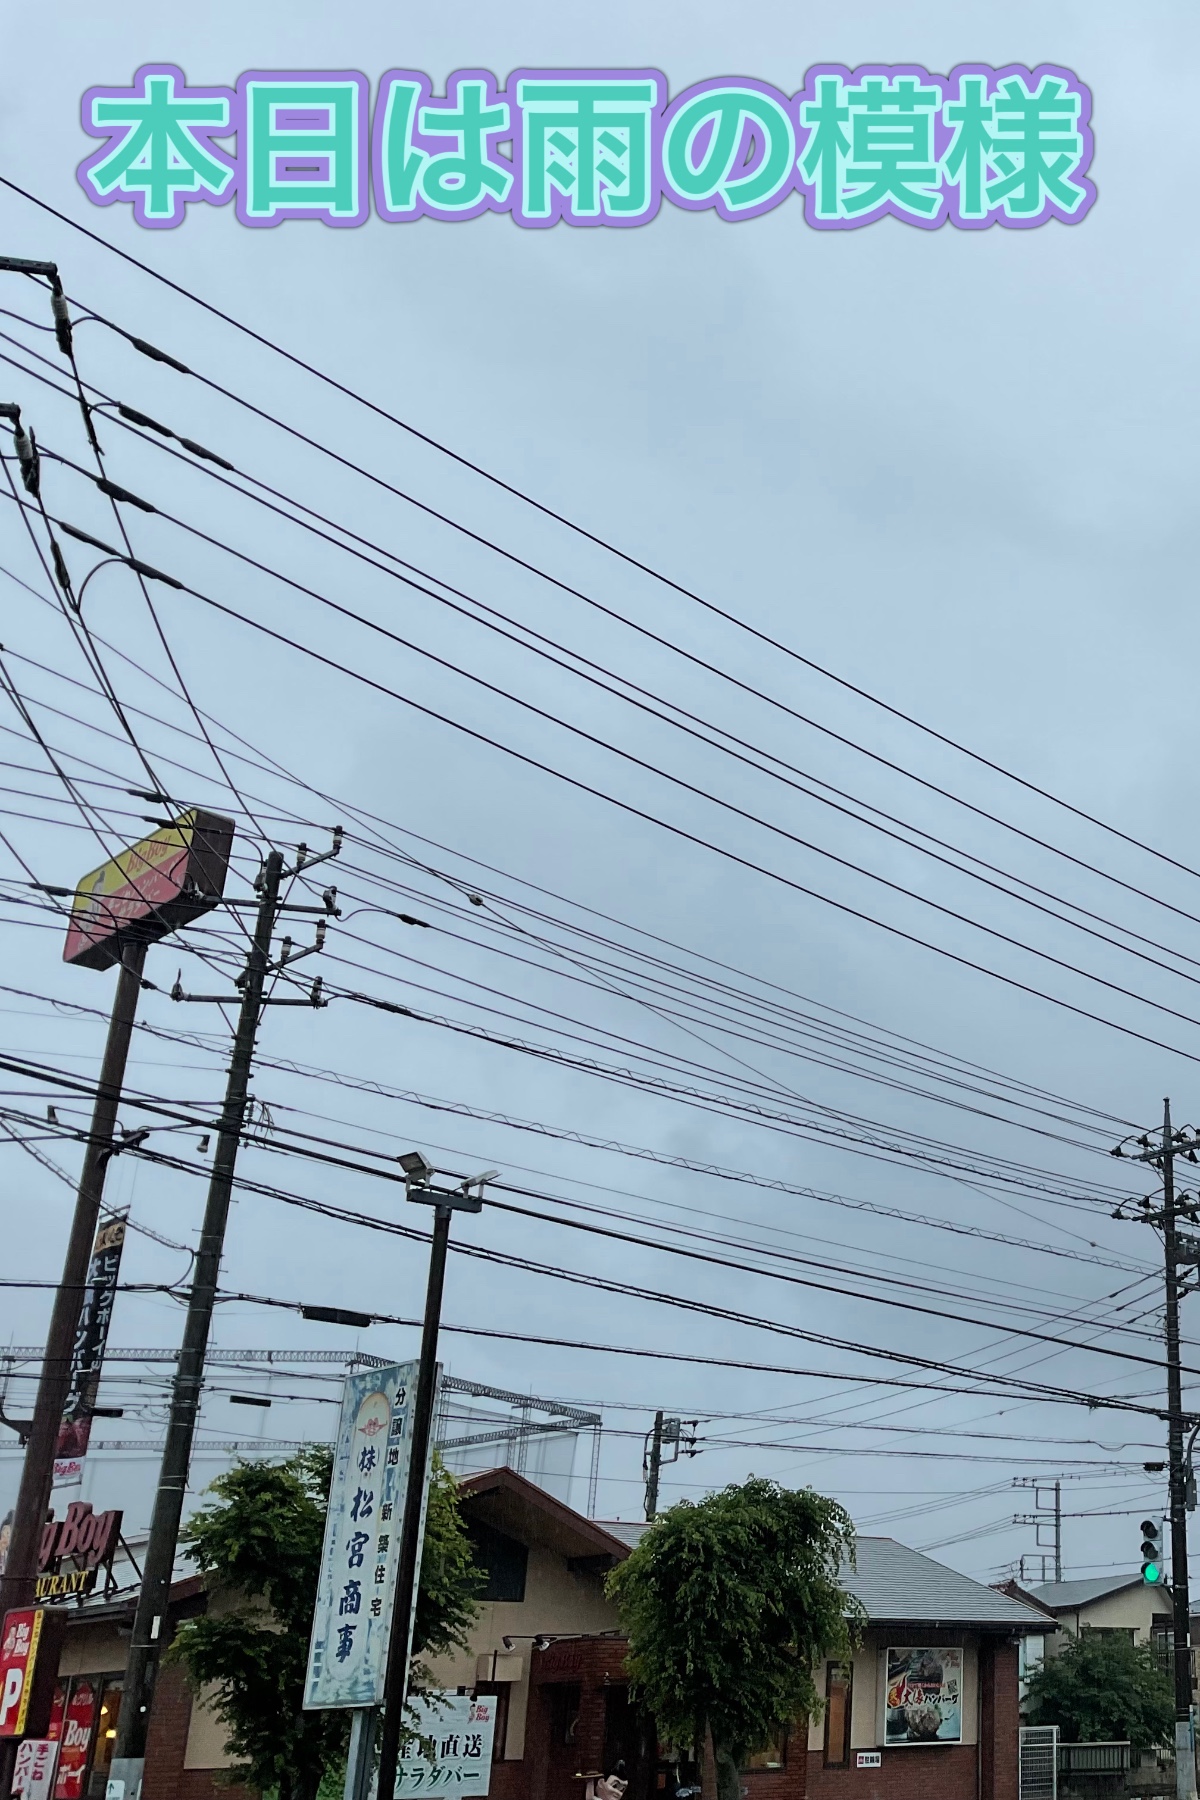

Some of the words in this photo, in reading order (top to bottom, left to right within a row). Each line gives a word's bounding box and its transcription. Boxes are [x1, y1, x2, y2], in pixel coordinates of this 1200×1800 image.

[55, 1501, 117, 1564] Boy
[35, 1571, 89, 1598] AURANT
[16, 1622, 30, 1640] Big
[0, 1668, 23, 1726] P
[475, 1704, 489, 1714] Big
[475, 1713, 490, 1723] Boy
[64, 1719, 92, 1753] Boy
